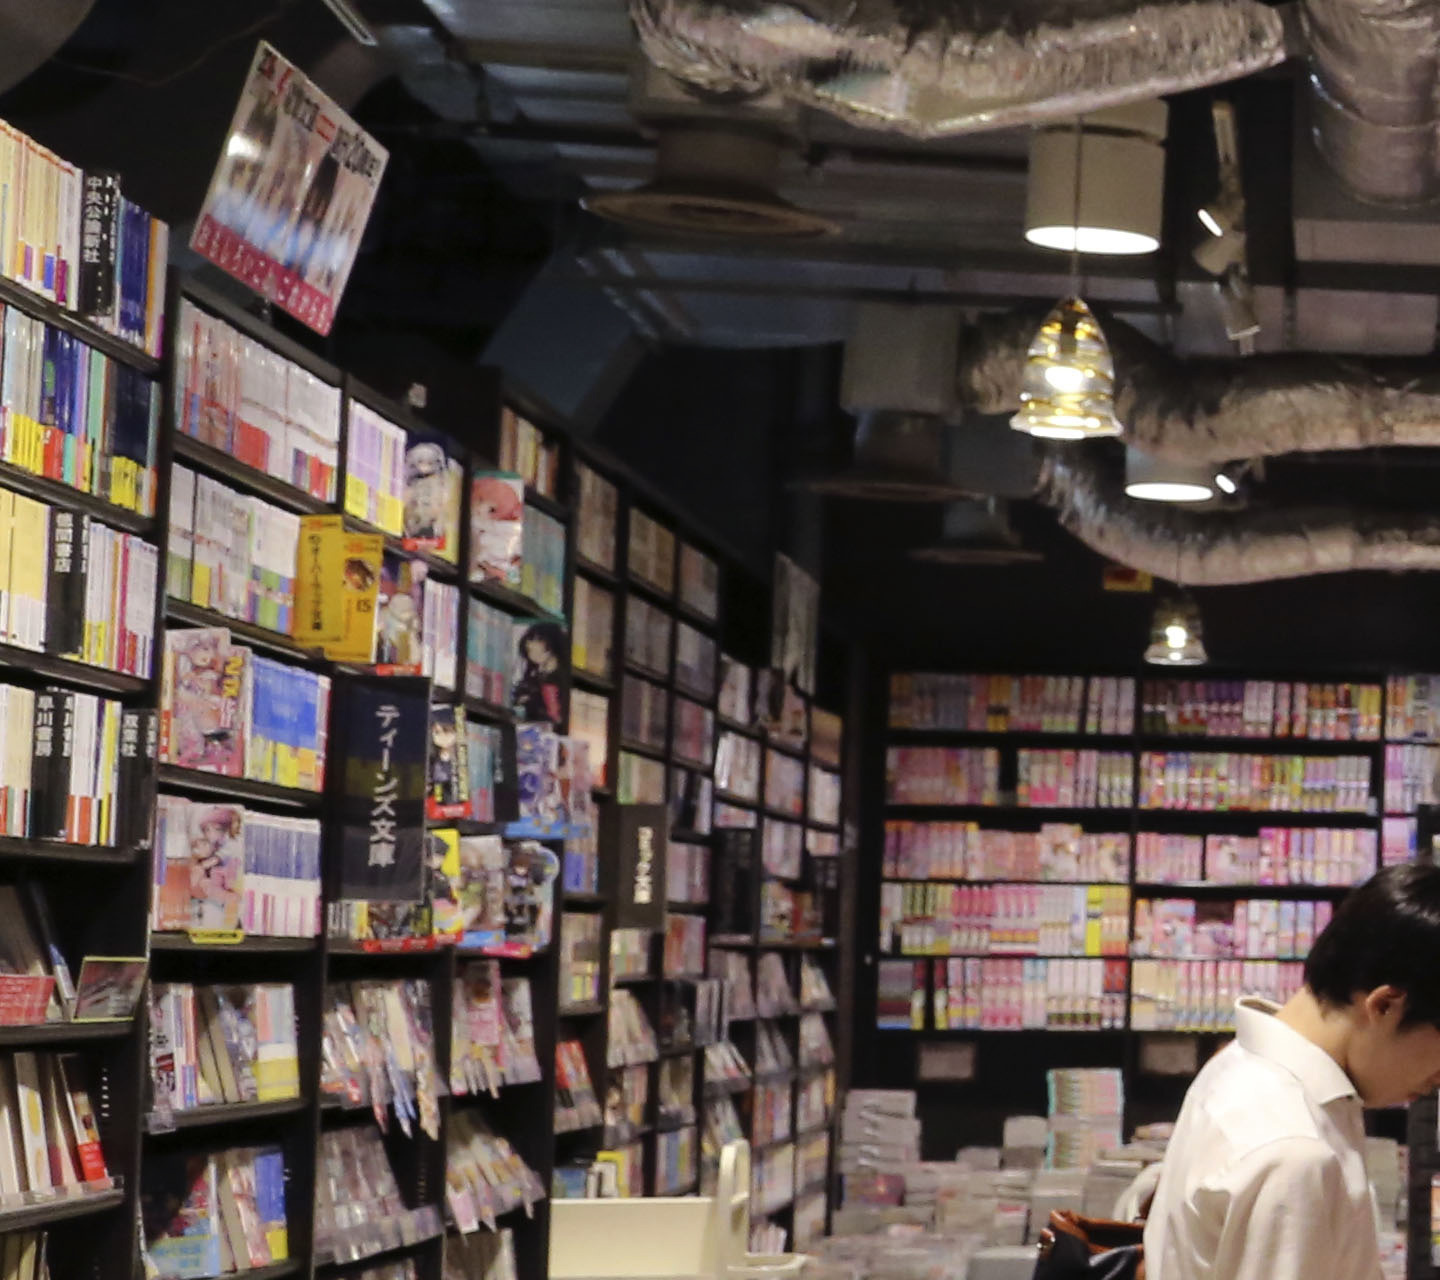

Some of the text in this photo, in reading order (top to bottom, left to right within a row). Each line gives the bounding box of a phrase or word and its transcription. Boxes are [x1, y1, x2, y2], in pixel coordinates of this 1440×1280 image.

[36, 695, 54, 758] 早川書房
[367, 703, 400, 868] ティーンズ文庫
